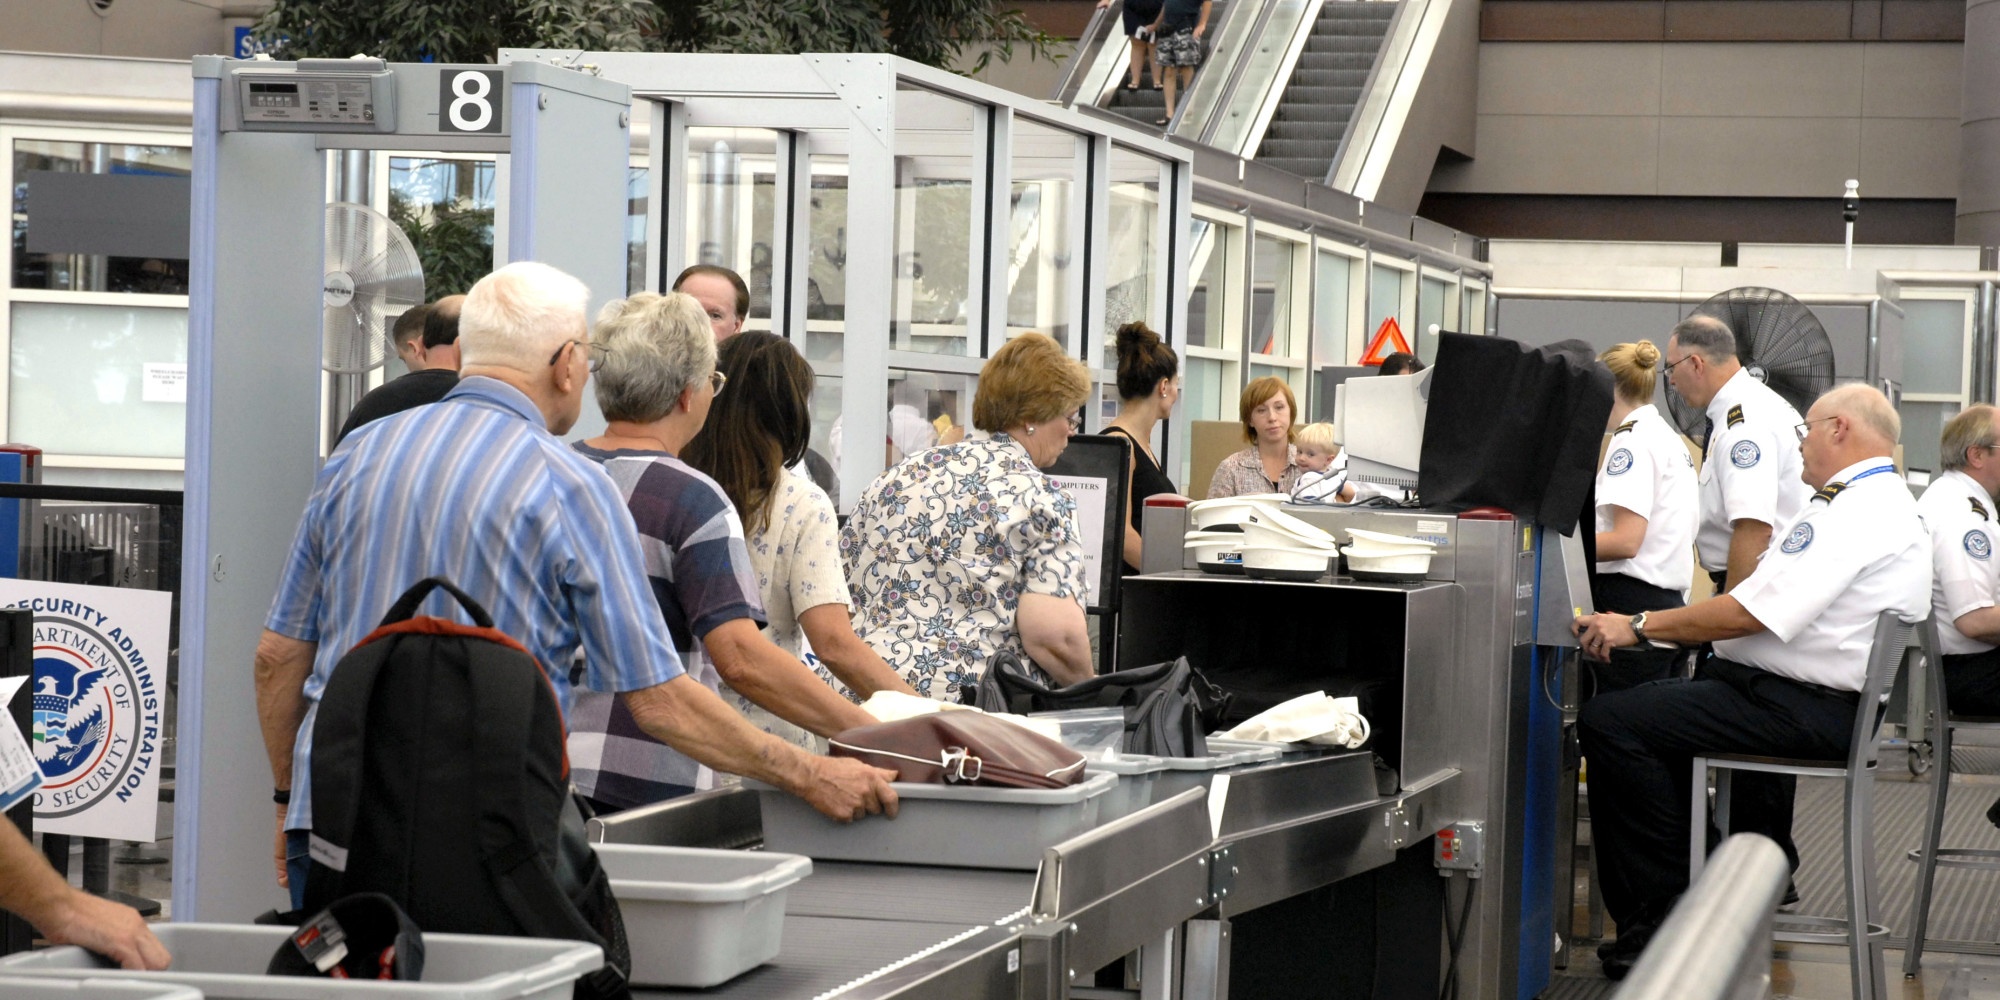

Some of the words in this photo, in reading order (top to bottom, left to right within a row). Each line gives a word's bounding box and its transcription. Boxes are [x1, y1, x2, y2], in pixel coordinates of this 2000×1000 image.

[449, 71, 492, 131] 8
[1061, 482, 1100, 490] MPUTERS
[6, 597, 108, 627] ECURITY
[108, 626, 158, 803] ADMINISTRATION
[34, 627, 121, 682] ARTMENT
[113, 684, 130, 709] OF
[53, 735, 127, 808] SECURITY
